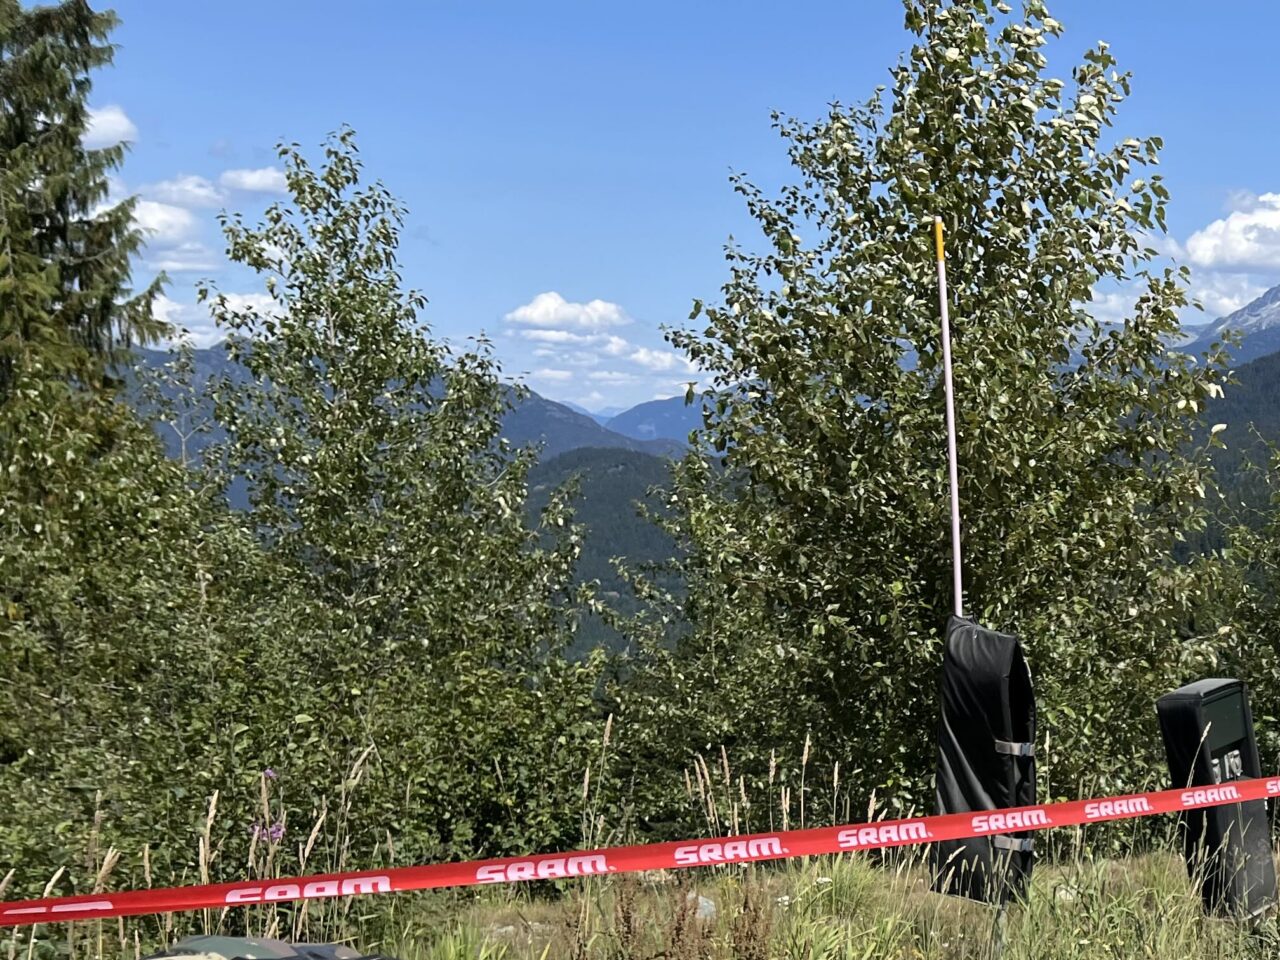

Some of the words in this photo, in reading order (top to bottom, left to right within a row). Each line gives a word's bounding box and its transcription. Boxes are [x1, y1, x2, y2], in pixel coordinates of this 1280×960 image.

[477, 852, 607, 882] SRAM
[675, 837, 781, 864] SRAM
[838, 822, 925, 848] SRAM
[972, 808, 1046, 832] SRAM
[1085, 796, 1150, 818] SRAM
[1181, 785, 1236, 806] SRAM
